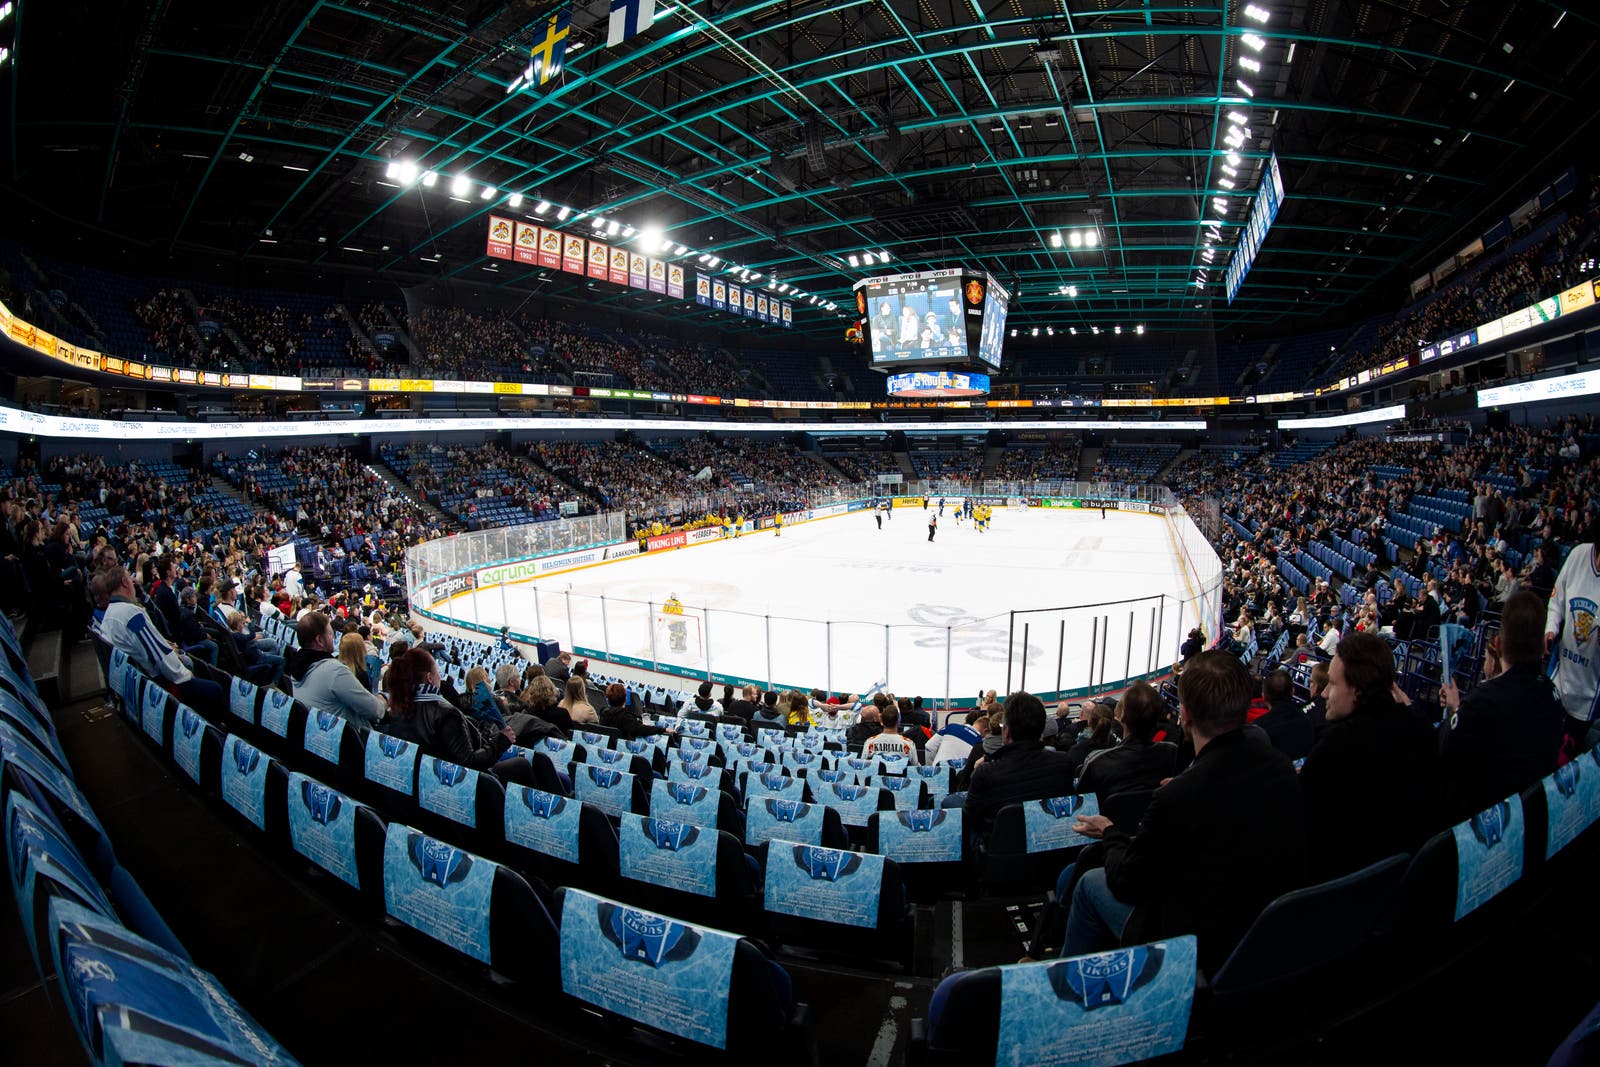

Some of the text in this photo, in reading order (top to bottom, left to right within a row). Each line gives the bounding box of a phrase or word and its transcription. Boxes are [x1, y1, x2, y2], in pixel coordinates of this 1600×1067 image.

[493, 247, 507, 255] 1973
[520, 252, 532, 260] 1992
[648, 535, 684, 550] VIKING LINE
[482, 562, 536, 584] caruna
[1562, 648, 1589, 668] SUOMI
[873, 743, 903, 753] KARJALA
[626, 917, 663, 935] SUOMI
[1086, 960, 1127, 976] SUOMI
